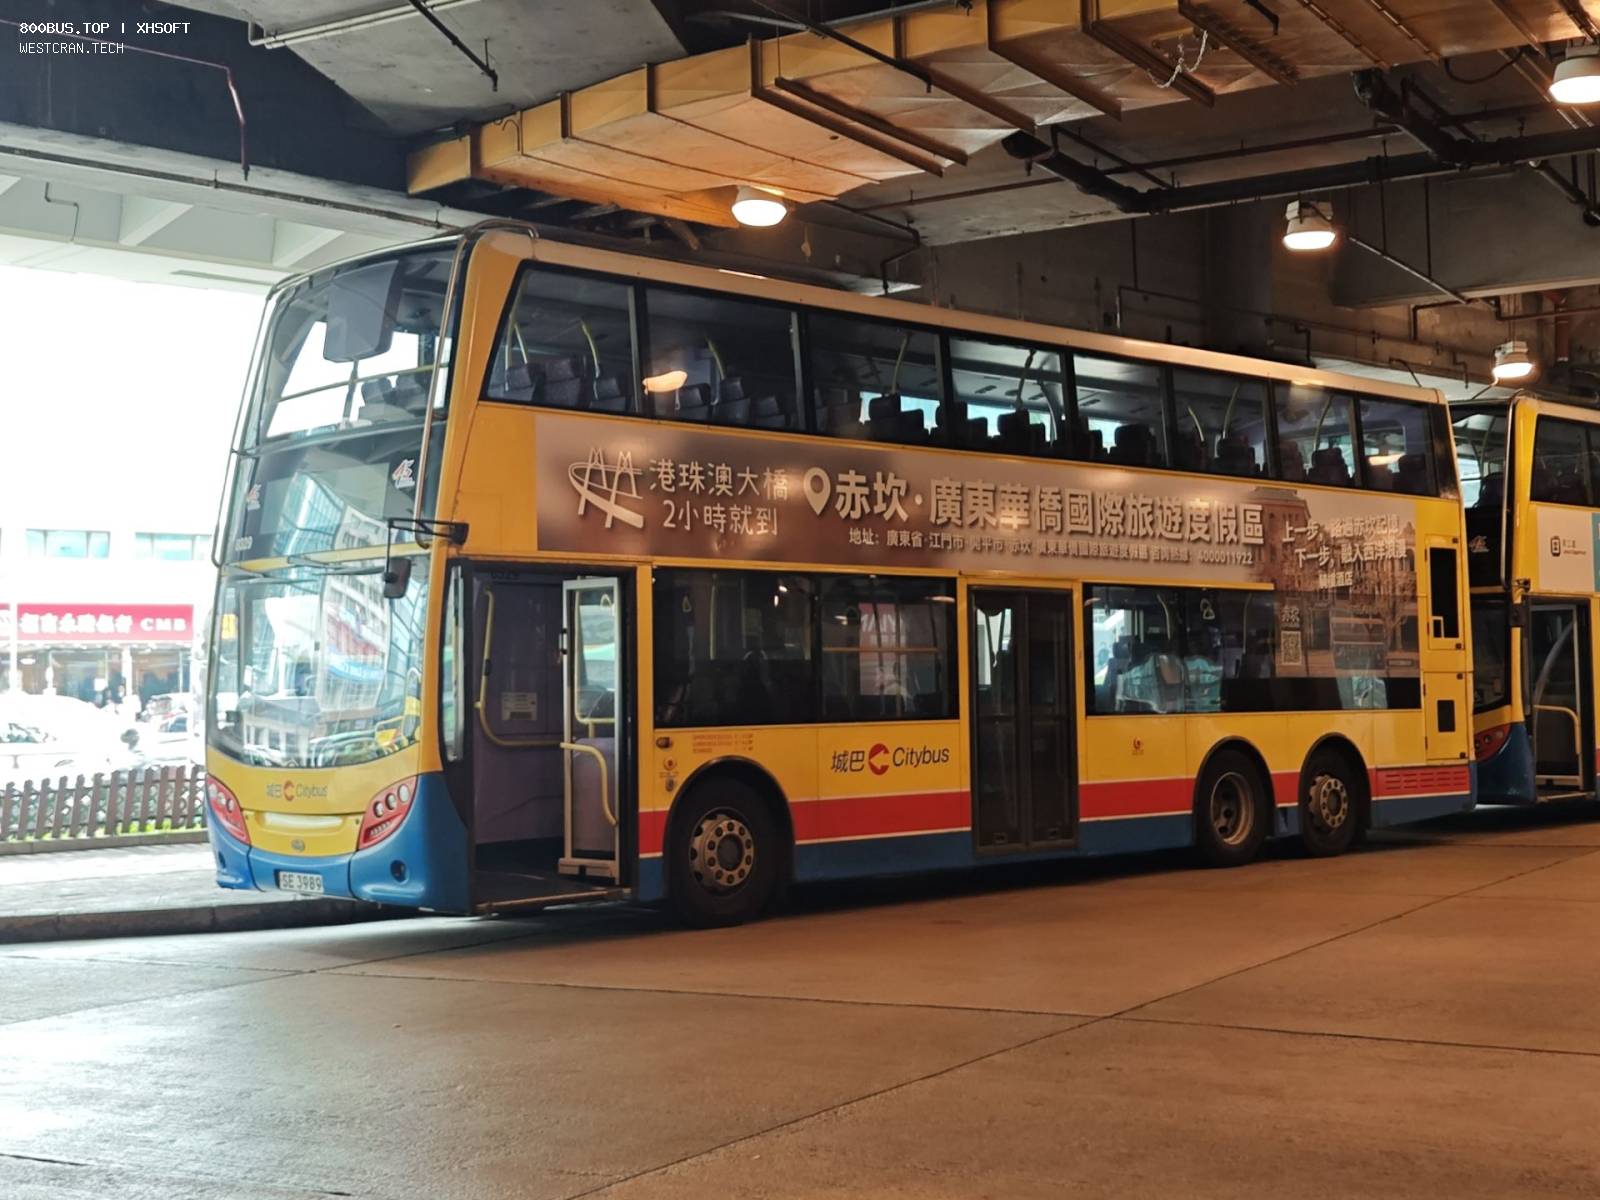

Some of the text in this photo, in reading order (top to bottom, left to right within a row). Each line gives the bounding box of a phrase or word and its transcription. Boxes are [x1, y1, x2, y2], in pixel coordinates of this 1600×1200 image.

[649, 458, 789, 501] 港珠澳大橋
[662, 500, 779, 536] 2小時就到
[139, 617, 187, 632] CMB
[830, 750, 865, 774] 城巴
[892, 744, 950, 768] Citybus
